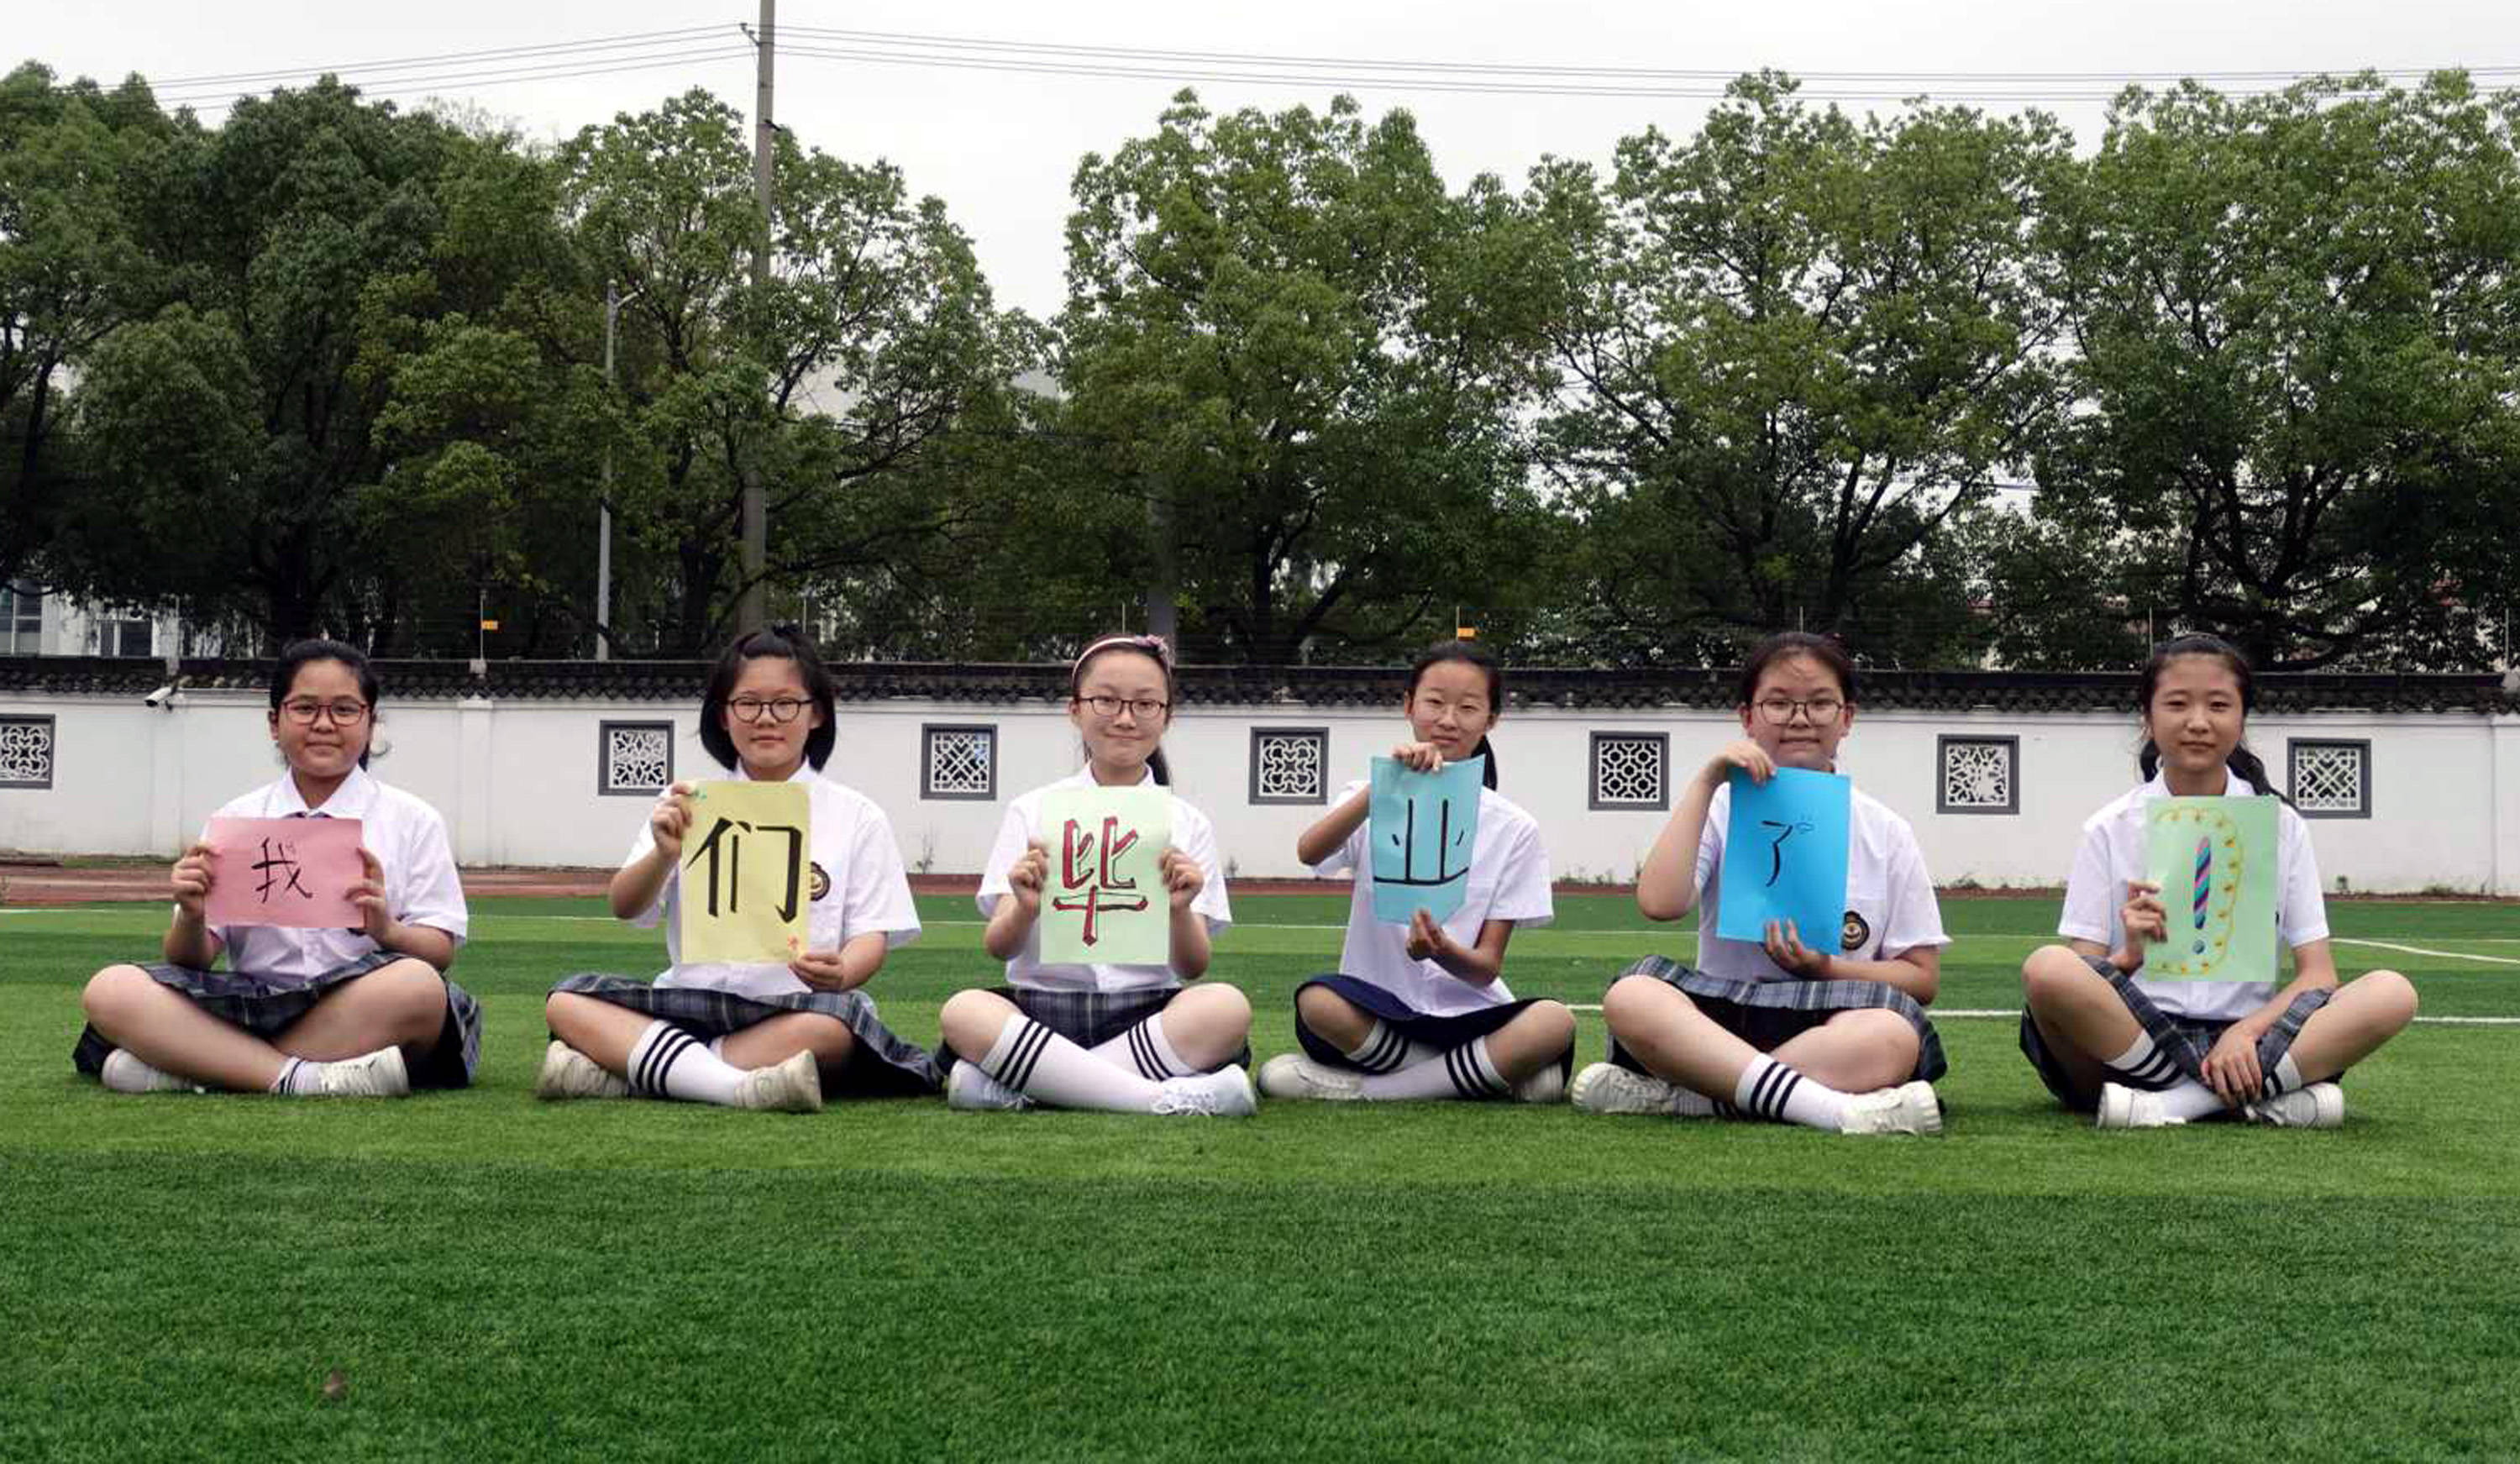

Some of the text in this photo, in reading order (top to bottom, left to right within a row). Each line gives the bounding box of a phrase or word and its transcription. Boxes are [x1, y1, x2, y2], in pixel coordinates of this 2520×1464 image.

[252, 837, 312, 905] 我
[686, 816, 802, 924] 们
[1053, 816, 1149, 947] 毕
[1373, 798, 1470, 886] 业
[1761, 820, 1793, 888] 了
